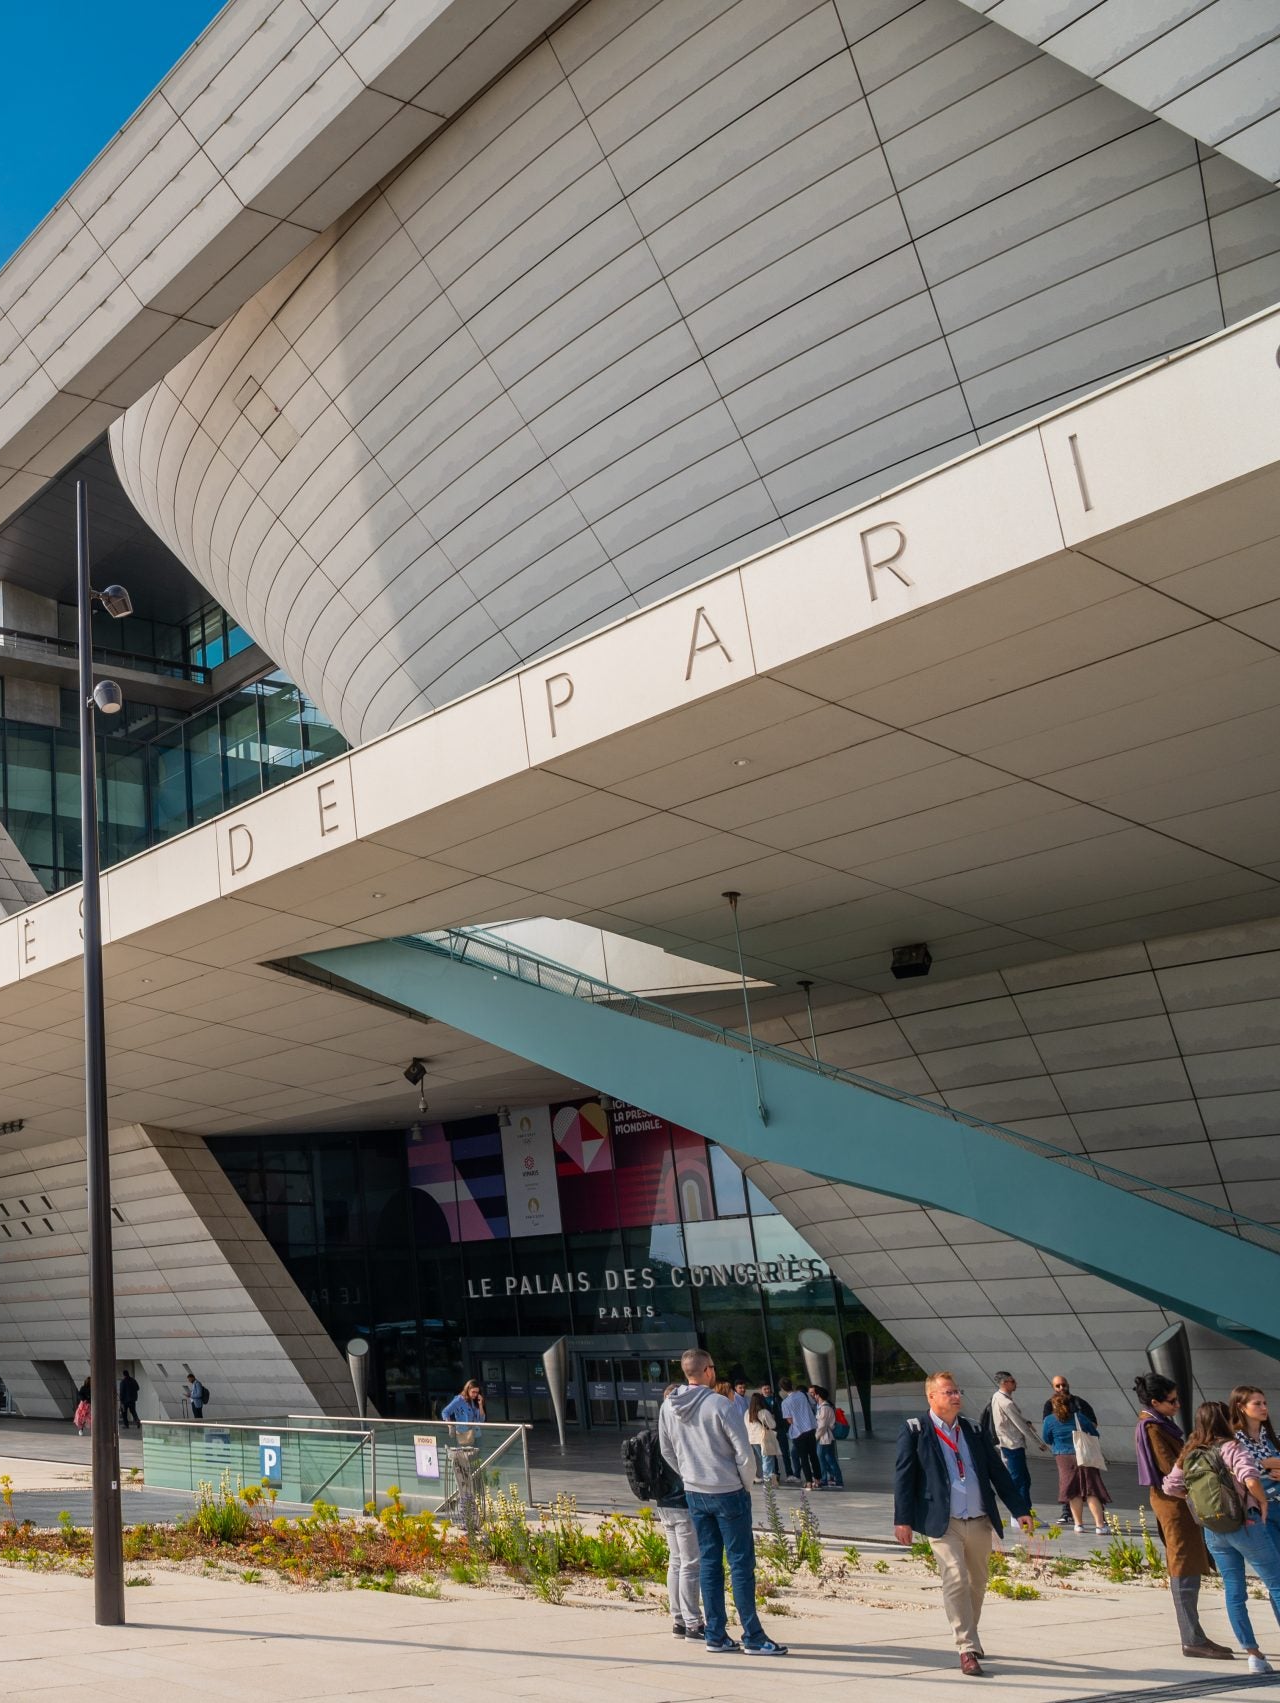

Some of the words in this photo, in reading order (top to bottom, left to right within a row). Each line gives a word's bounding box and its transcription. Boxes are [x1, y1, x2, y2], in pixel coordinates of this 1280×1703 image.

[228, 779, 340, 877] DE
[544, 343, 1280, 739] PARI
[613, 1111, 624, 1122] LA
[625, 1109, 654, 1121] PRES
[615, 1118, 663, 1136] MONDIALE.
[468, 1278, 493, 1299] LE
[505, 1271, 591, 1296] PALAIS
[605, 1267, 656, 1291] DES
[671, 1254, 814, 1289] CONGRÈS
[599, 1305, 656, 1319] PARIS
[263, 1448, 277, 1476] P
